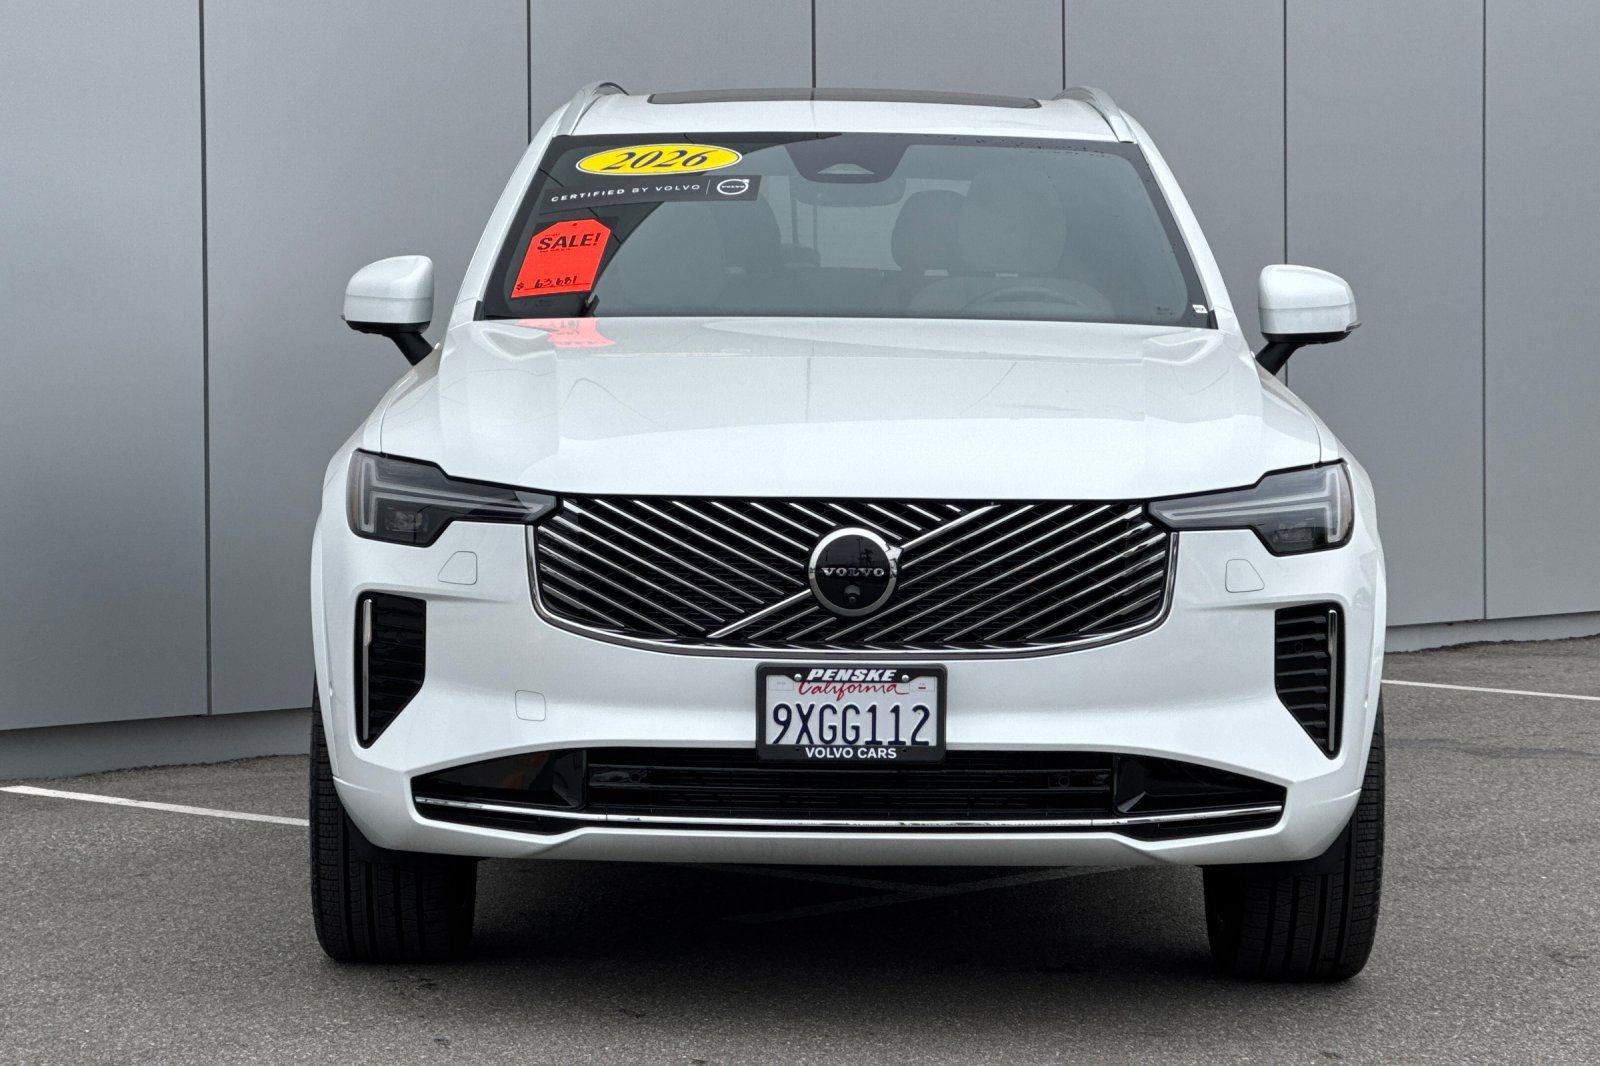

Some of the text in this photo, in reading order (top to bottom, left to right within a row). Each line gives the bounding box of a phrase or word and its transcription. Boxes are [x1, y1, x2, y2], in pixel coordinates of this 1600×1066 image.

[602, 149, 709, 171] 2026
[551, 188, 625, 202] CERTIFIED
[655, 184, 701, 192] VOLVO
[537, 232, 602, 251] SALE!
[821, 566, 885, 577] VOLVO
[806, 668, 897, 682] PENSKE
[798, 681, 910, 701] California
[772, 703, 931, 746] 9XGG112
[805, 747, 897, 759] VOLVO CARS
